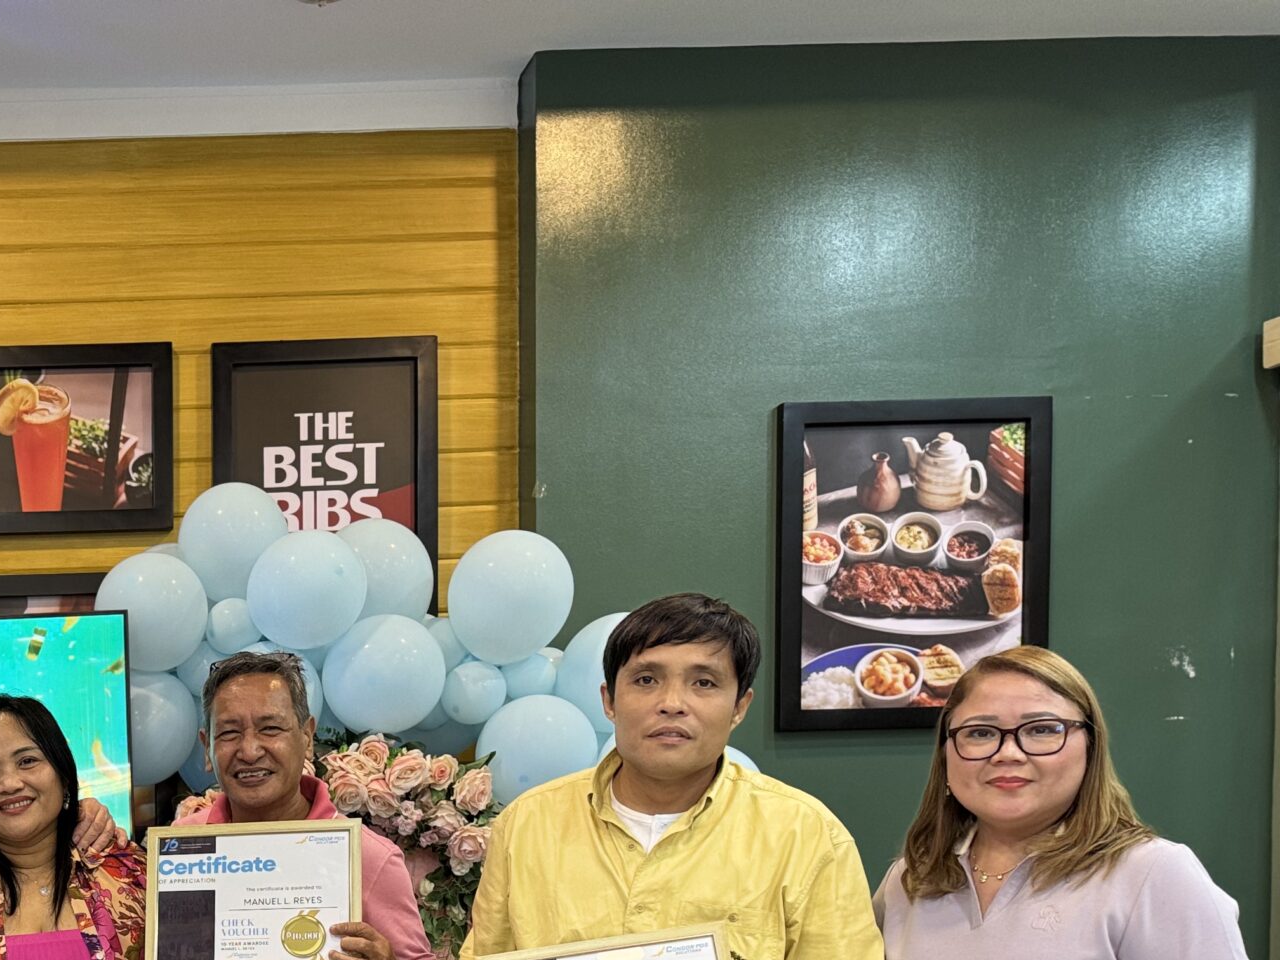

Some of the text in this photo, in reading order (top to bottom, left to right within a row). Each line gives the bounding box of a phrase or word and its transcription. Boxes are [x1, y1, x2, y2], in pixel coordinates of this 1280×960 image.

[294, 411, 354, 441] THE
[263, 442, 385, 488] BEST
[158, 855, 277, 876] Certificate
[243, 898, 282, 906] MANUEL
[293, 896, 323, 904] REYES
[221, 918, 254, 927] CHECK
[221, 928, 269, 937] VOUCHER
